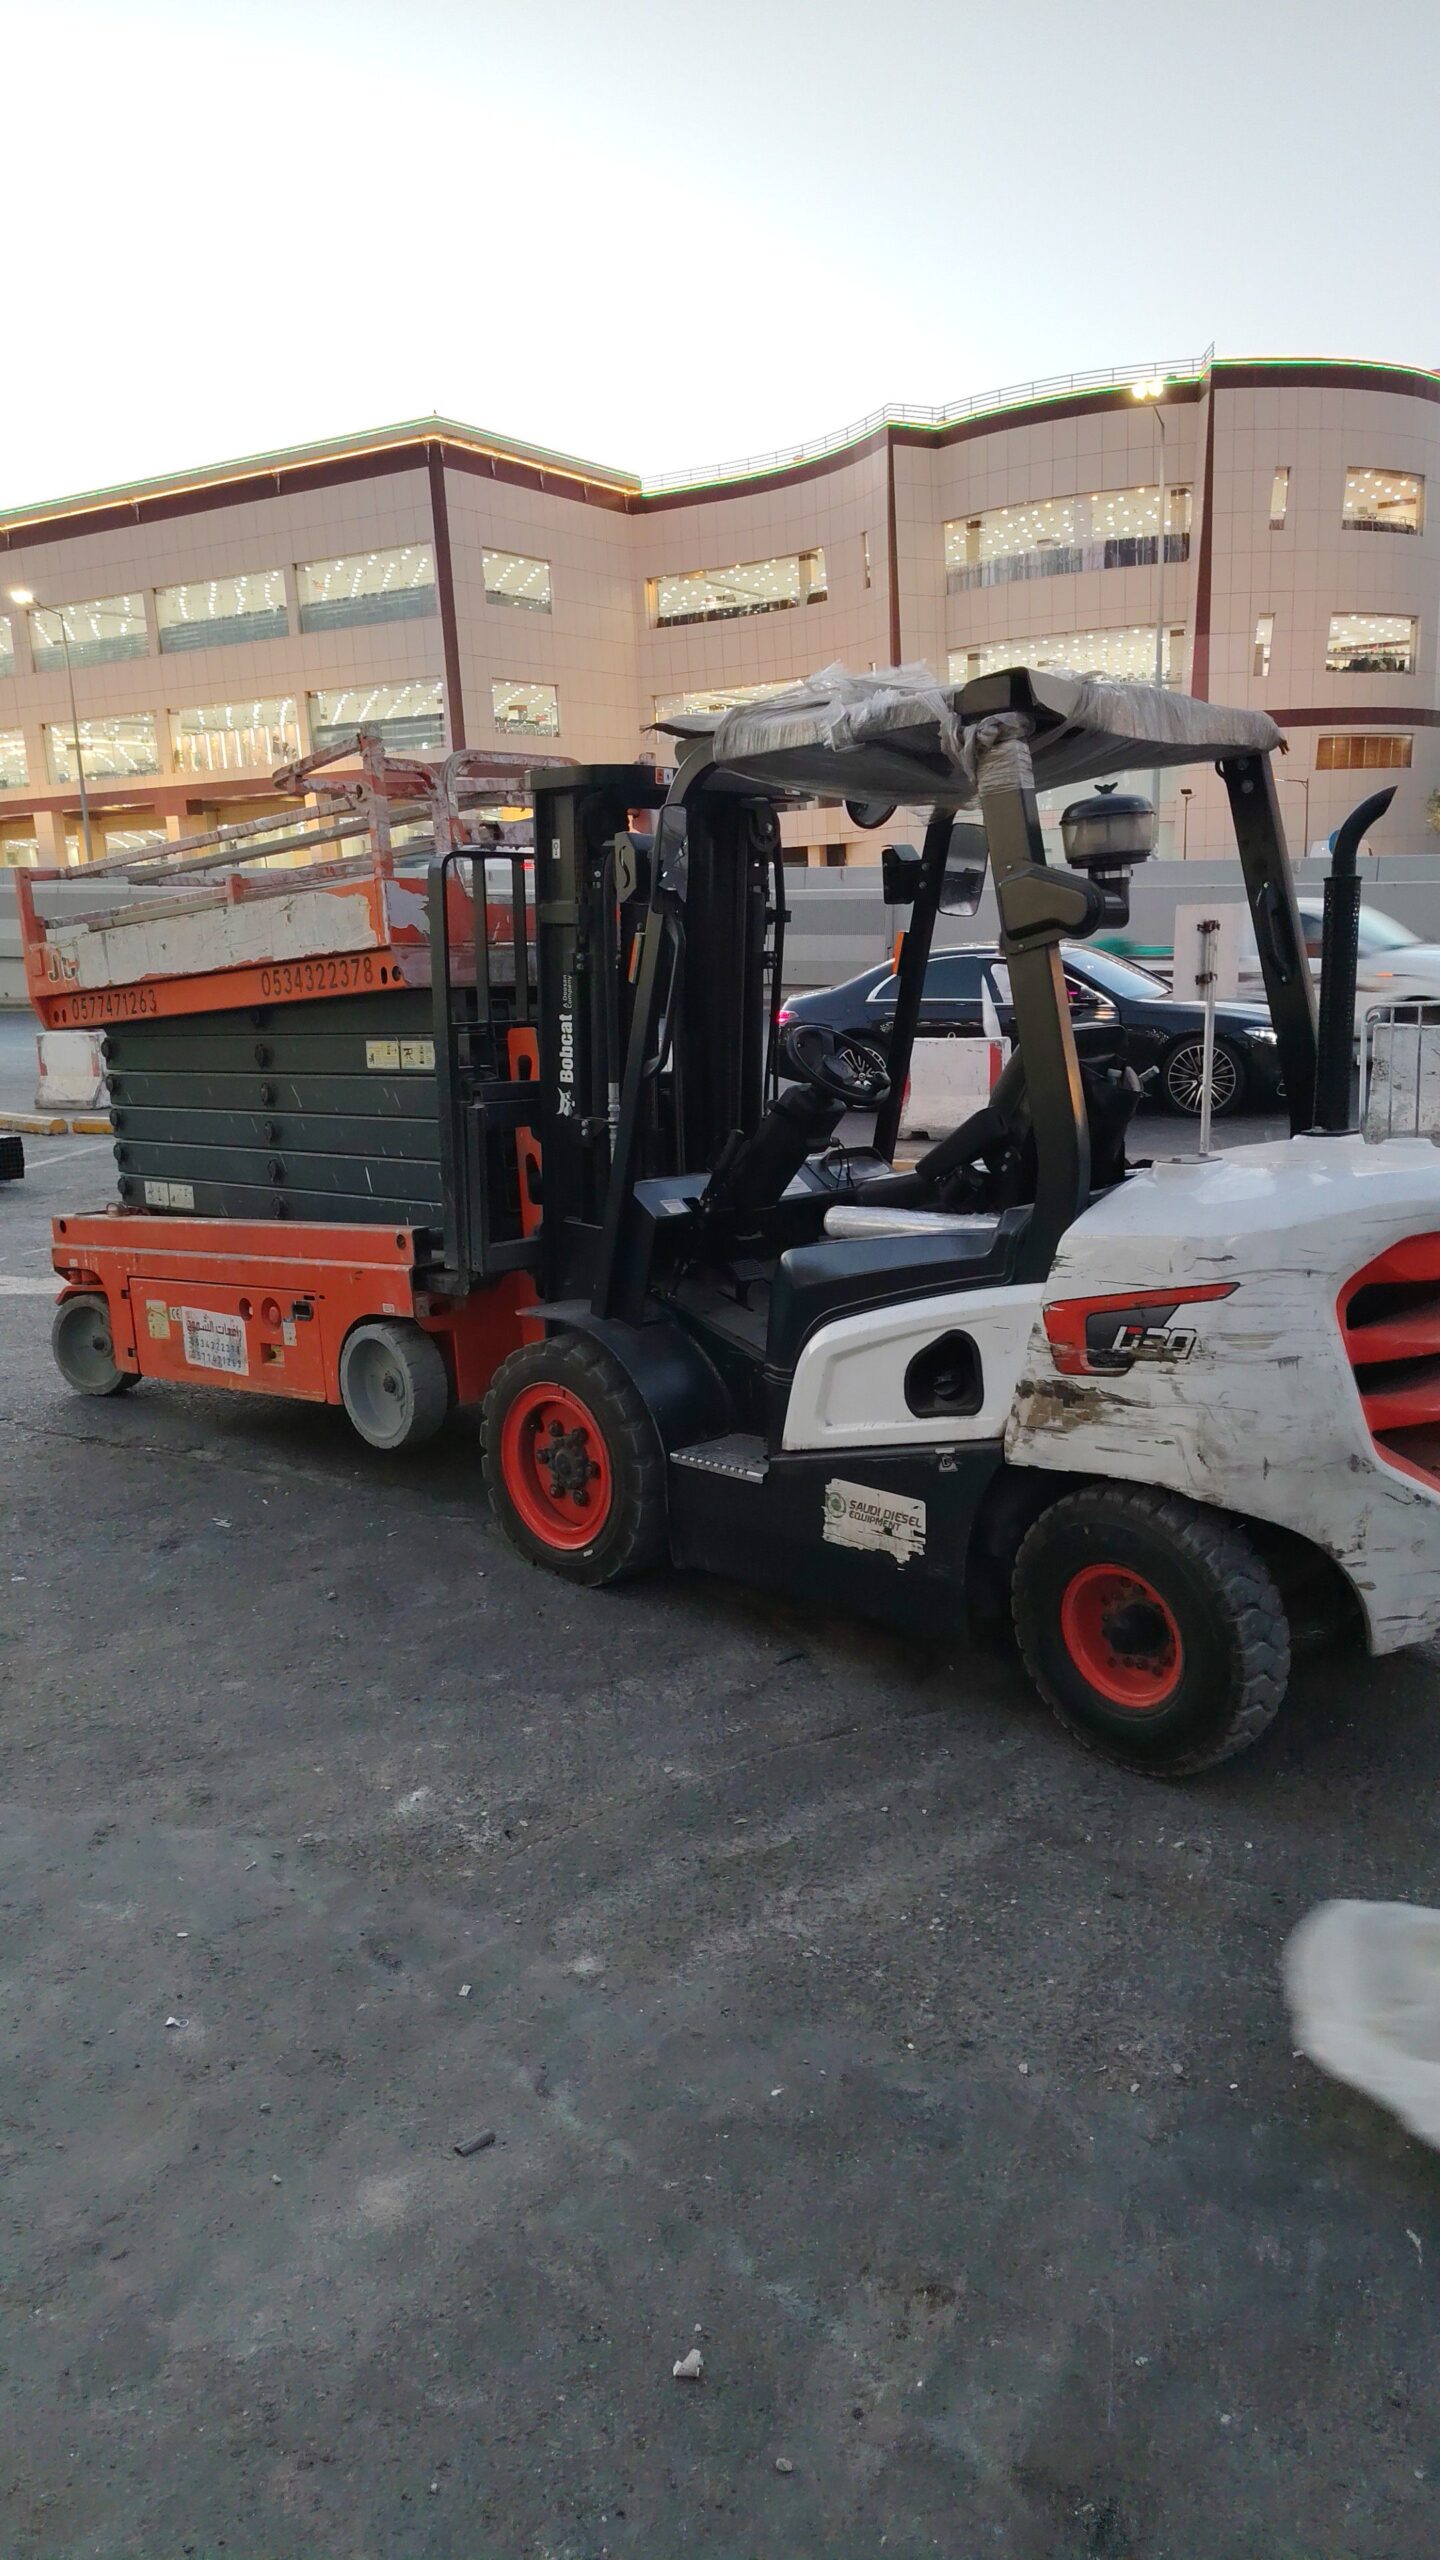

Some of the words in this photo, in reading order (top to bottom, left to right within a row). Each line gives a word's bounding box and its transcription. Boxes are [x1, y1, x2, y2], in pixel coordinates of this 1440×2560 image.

[261, 956, 374, 997] 0534322378
[71, 988, 158, 1020] 0577471263
[559, 1013, 574, 1084] Bobcat
[848, 1510, 902, 1532] EQUIPMENT
[849, 1499, 882, 1518] SAUDI
[883, 1508, 922, 1528] DIESEL
